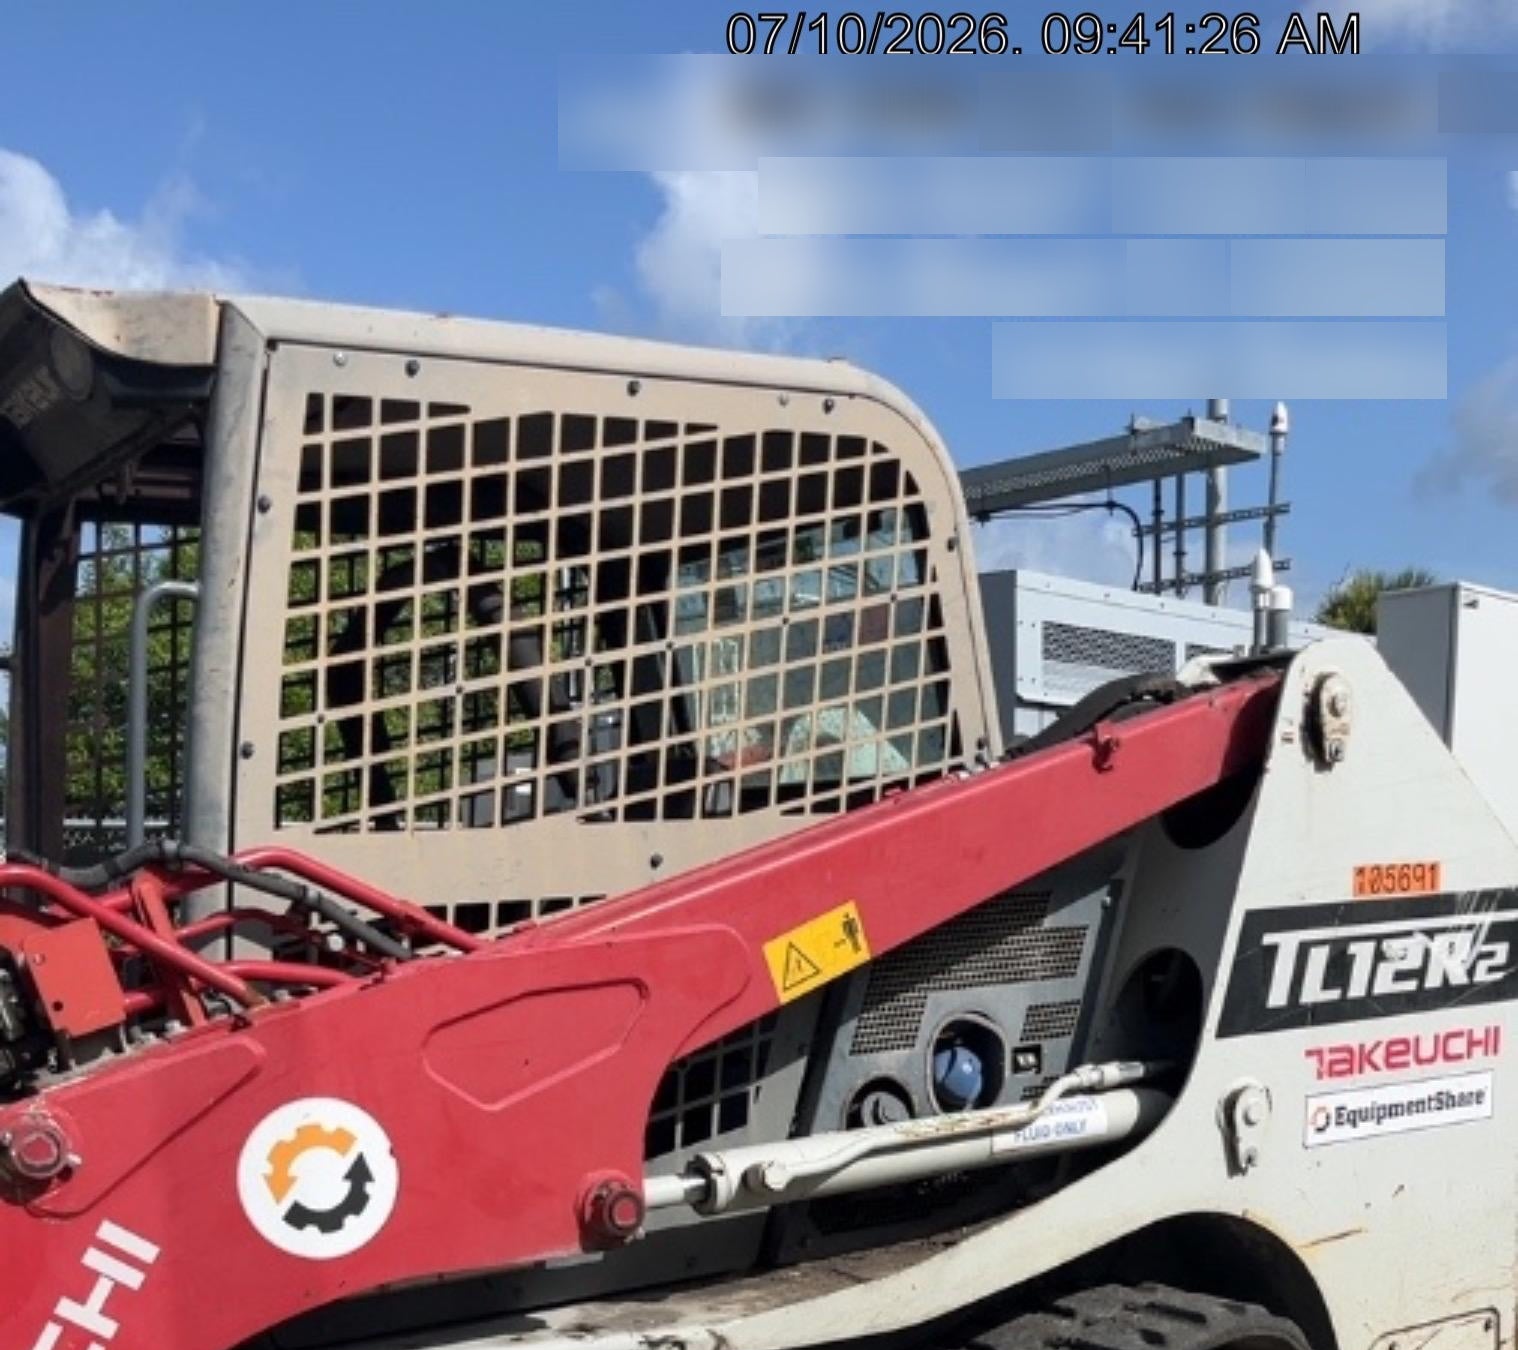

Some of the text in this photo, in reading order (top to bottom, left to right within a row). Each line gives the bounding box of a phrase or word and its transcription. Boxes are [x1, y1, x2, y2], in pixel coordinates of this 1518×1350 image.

[1355, 863, 1437, 894] 105691
[1262, 917, 1511, 1009] TL12R2
[1334, 1088, 1486, 1128] EquipmentShare
